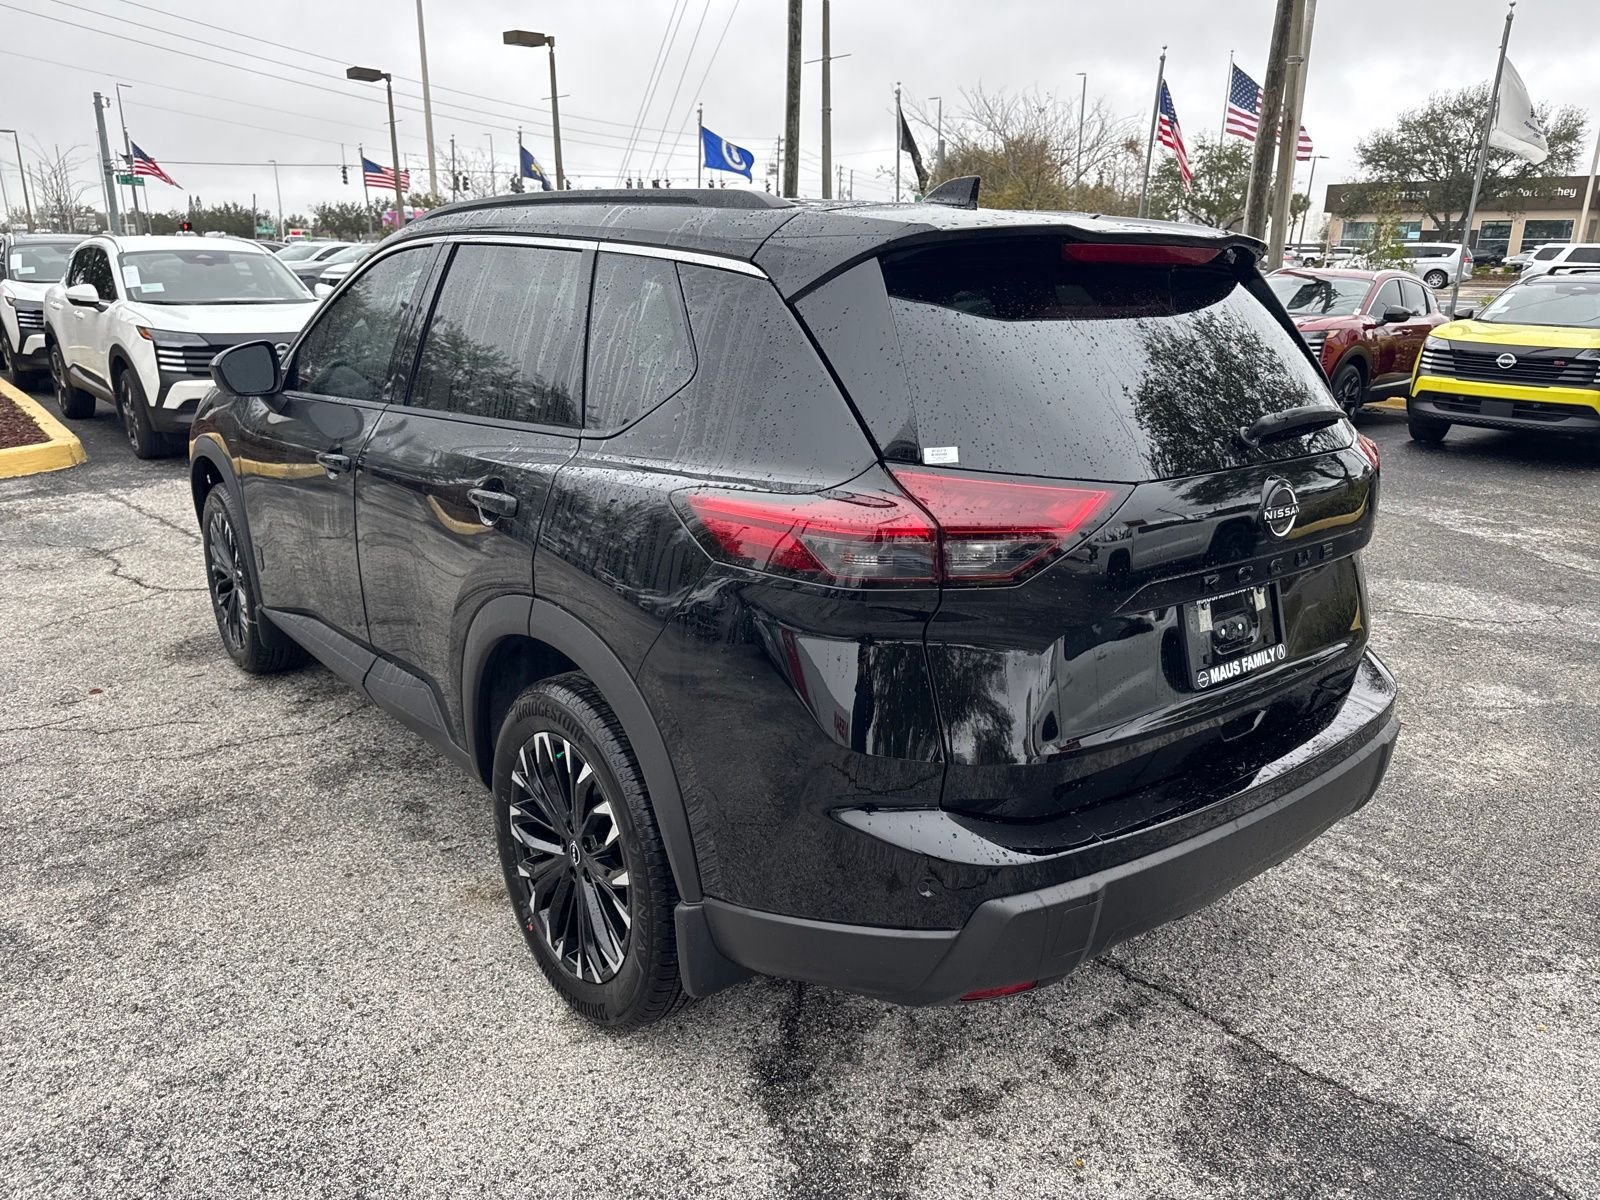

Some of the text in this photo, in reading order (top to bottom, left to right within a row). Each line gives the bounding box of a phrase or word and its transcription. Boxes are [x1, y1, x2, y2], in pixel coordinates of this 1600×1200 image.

[1264, 505, 1300, 520] NISSAN
[1202, 542, 1335, 595] ROGUE
[1210, 647, 1275, 684] MAUS FAMILY
[515, 701, 586, 746] BRIDGESTONE
